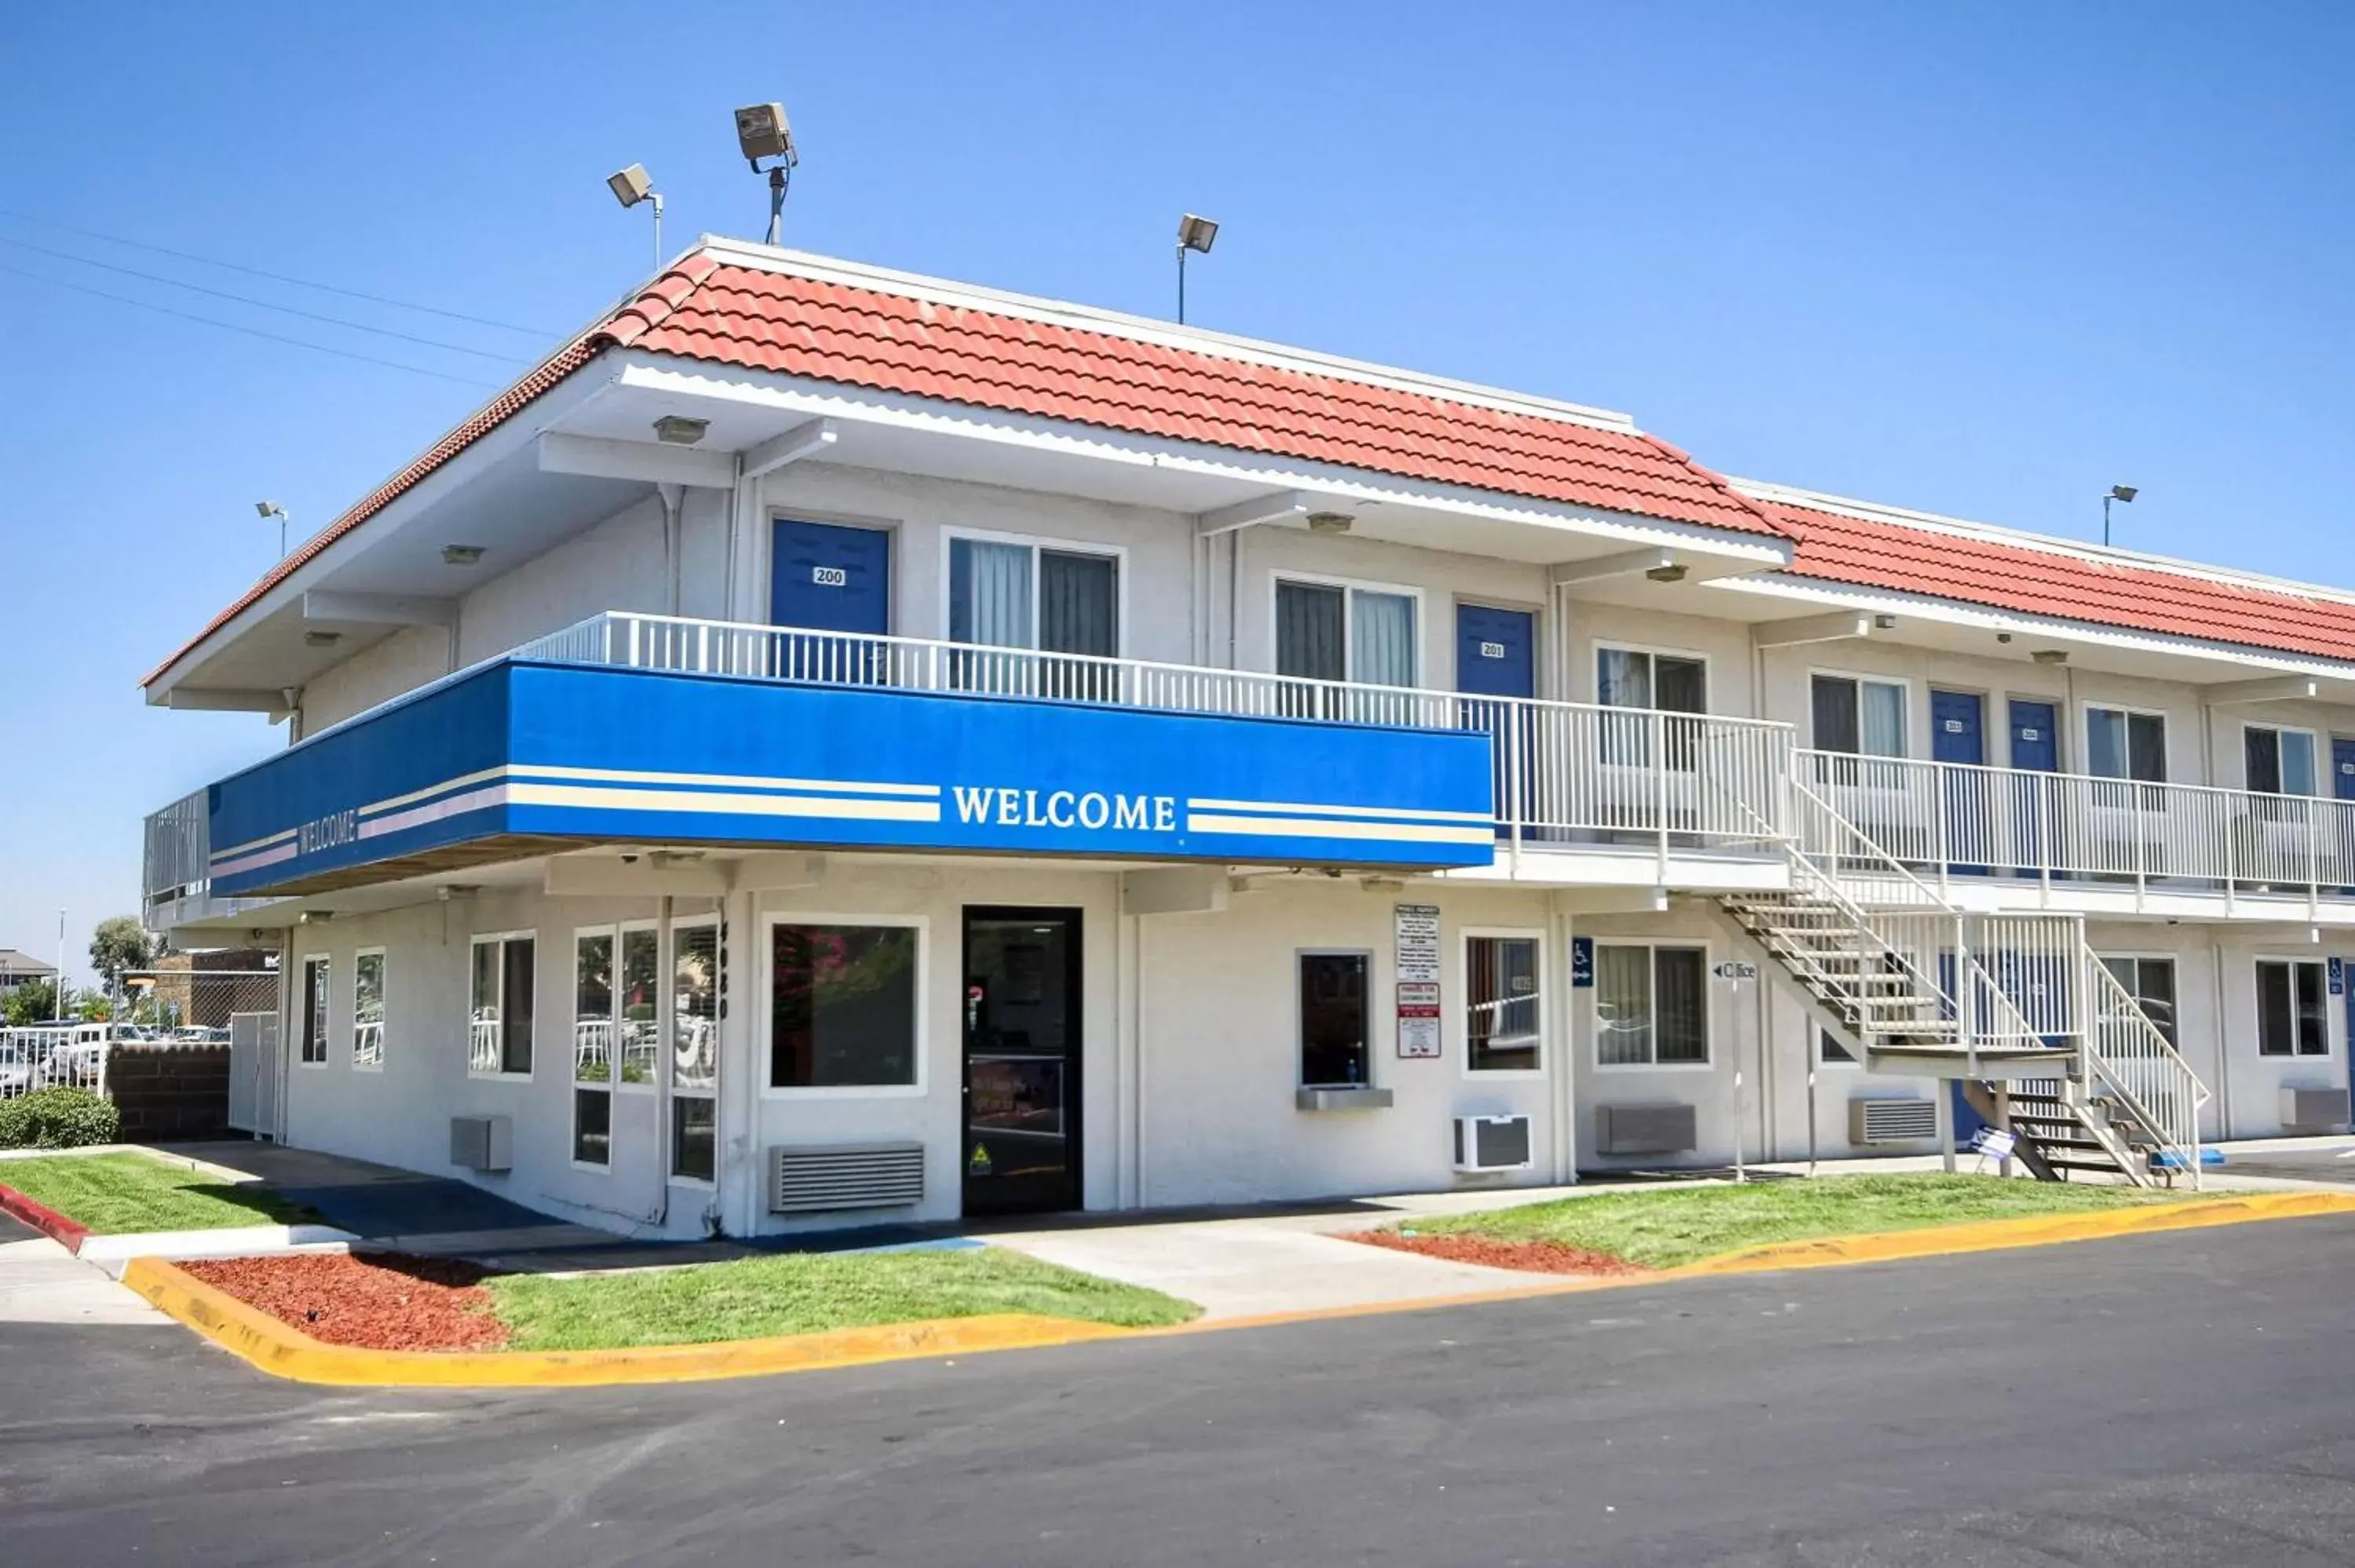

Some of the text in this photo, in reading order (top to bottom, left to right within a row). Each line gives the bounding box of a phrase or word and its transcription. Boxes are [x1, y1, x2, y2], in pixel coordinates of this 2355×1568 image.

[817, 569, 842, 583] 200
[1484, 644, 1502, 657] 201
[951, 786, 1177, 832] WELCOME
[299, 809, 355, 855] WELCOME
